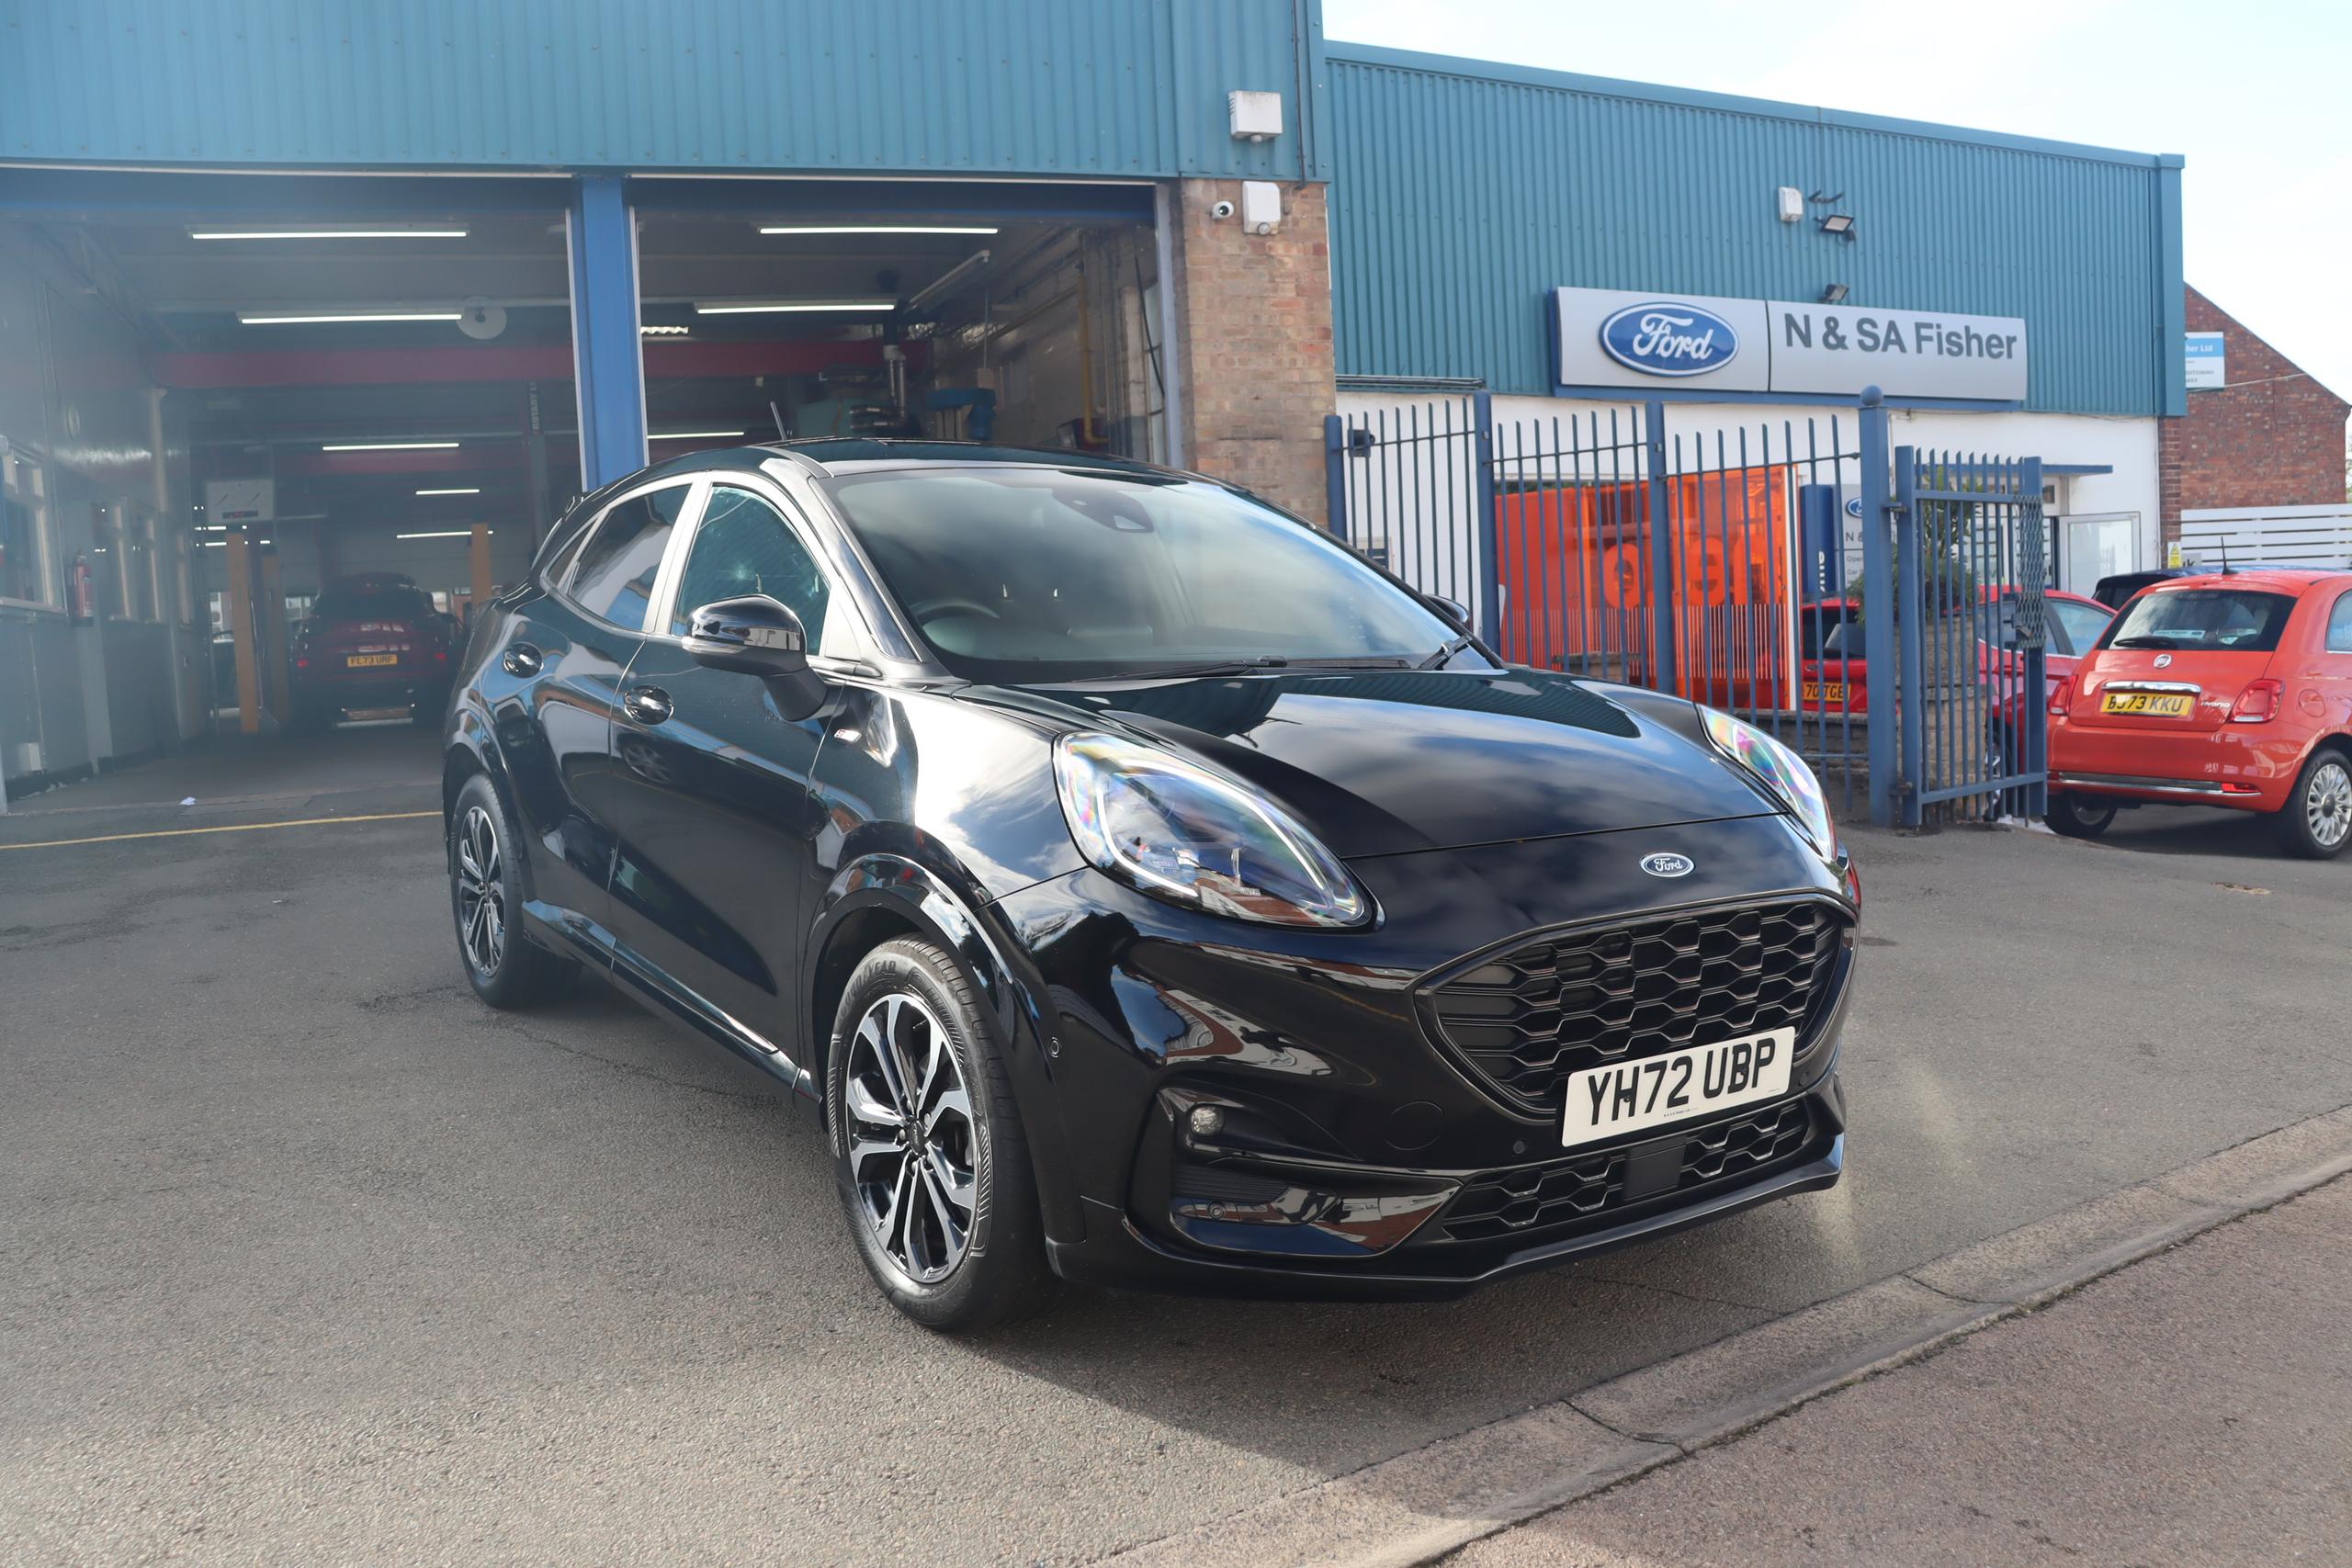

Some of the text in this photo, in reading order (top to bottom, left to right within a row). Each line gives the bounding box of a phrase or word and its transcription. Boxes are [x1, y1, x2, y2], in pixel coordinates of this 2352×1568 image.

[1633, 312, 1714, 360] Ford
[1784, 312, 2018, 359] N & SA Fisher
[2199, 344, 2213, 353] Ltd
[1845, 532, 1854, 542] N
[2149, 696, 2184, 713] KKU
[1588, 1037, 1776, 1126] YH72 UBP
